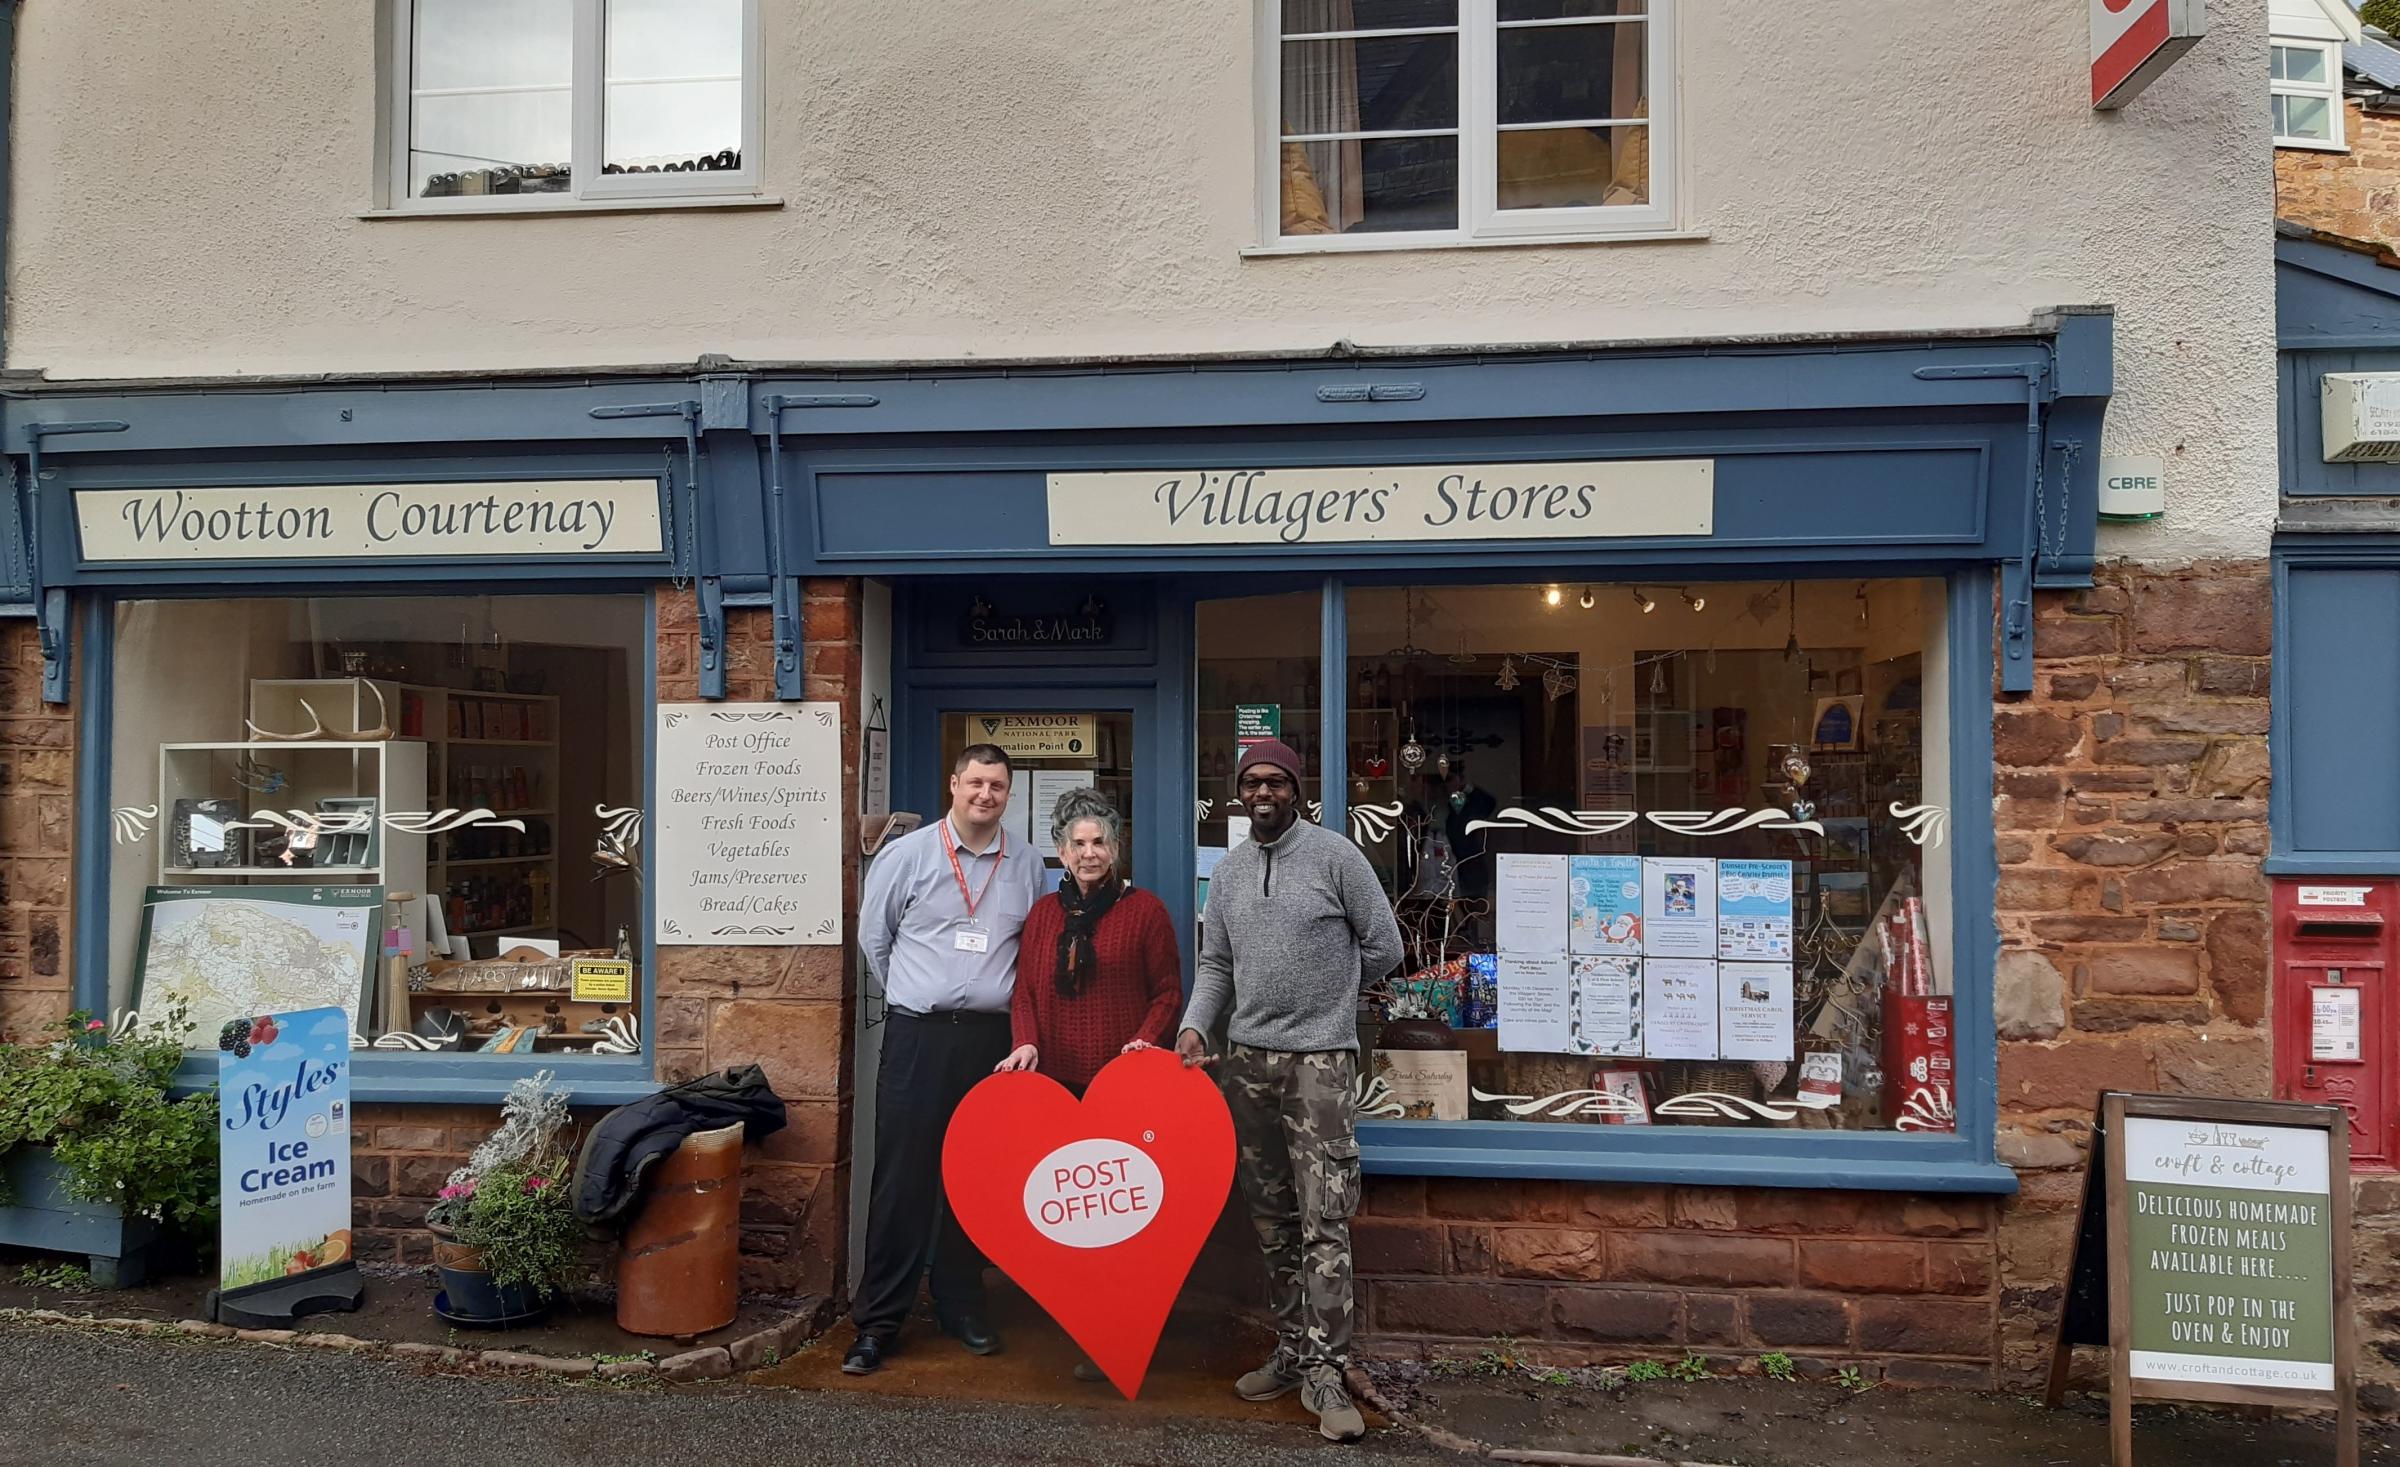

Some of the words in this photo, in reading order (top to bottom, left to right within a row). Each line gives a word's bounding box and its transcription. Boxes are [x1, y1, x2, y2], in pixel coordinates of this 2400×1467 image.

[2107, 476, 2157, 490] CBRE
[1154, 471, 1400, 544] Villagers'
[1423, 474, 1598, 528] Stores
[122, 490, 334, 543] Wootton
[365, 491, 615, 551] Courtenay
[972, 618, 1028, 642] Sarah
[1033, 618, 1050, 641] &
[1050, 618, 1105, 641] Mark
[1003, 716, 1079, 727] EXMOOR
[705, 733, 738, 749] Post
[743, 731, 791, 753] Office
[1038, 742, 1065, 751] Point
[695, 760, 749, 776] Frozen
[754, 758, 802, 776] Foods
[670, 786, 828, 807] Beers/Wines/Spirits
[701, 813, 744, 830] Fresh
[748, 812, 797, 830] Foods
[706, 840, 791, 862] Vegetables
[689, 868, 808, 888] Jams/Preserves
[699, 895, 799, 916] Bread/Cakes
[593, 967, 619, 975] AWARE
[225, 1059, 338, 1131] Styles
[268, 1140, 309, 1164] Ice
[240, 1158, 336, 1193] Cream
[1053, 1157, 1131, 1193] POST
[2154, 1152, 2203, 1177] croft
[2209, 1154, 2225, 1176] &
[2232, 1154, 2298, 1185] cottage
[239, 1191, 287, 1208] Homemade
[288, 1188, 300, 1198] on
[301, 1184, 315, 1194] the
[316, 1180, 336, 1193] farm
[1040, 1185, 1149, 1225] OFFICE
[2228, 1200, 2318, 1226] HOMEMADE
[2171, 1223, 2229, 1248] FROZEN
[2236, 1228, 2286, 1251] MEALS
[2150, 1250, 2234, 1276] AVAILABLE
[2165, 1292, 2201, 1315] JUST
[2207, 1295, 2235, 1317] POP
[2241, 1297, 2263, 1319] IN
[2270, 1299, 2296, 1321] THE
[2171, 1320, 2214, 1343] OVEN
[2221, 1322, 2234, 1345] &
[2146, 1360, 2318, 1380] www.croftandcottage.co.uk
